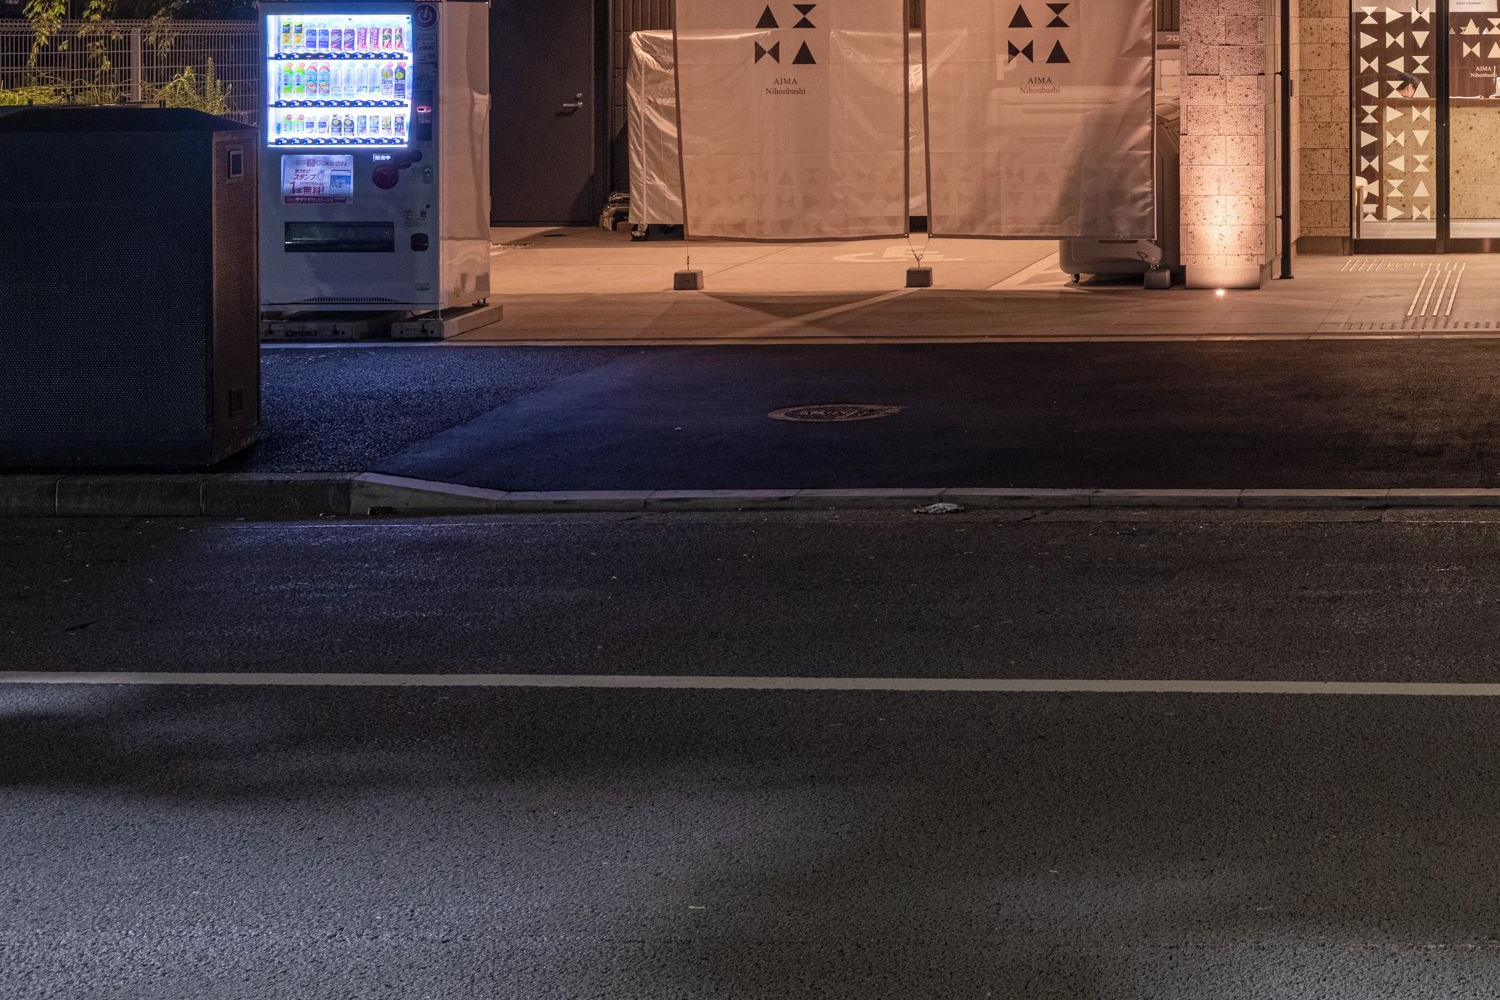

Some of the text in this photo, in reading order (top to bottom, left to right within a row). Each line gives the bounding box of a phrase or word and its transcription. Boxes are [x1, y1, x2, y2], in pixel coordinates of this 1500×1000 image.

[1027, 76, 1052, 84] AIMA
[765, 87, 806, 95] Nihonbashi
[1019, 86, 1061, 94] Nihonbashi
